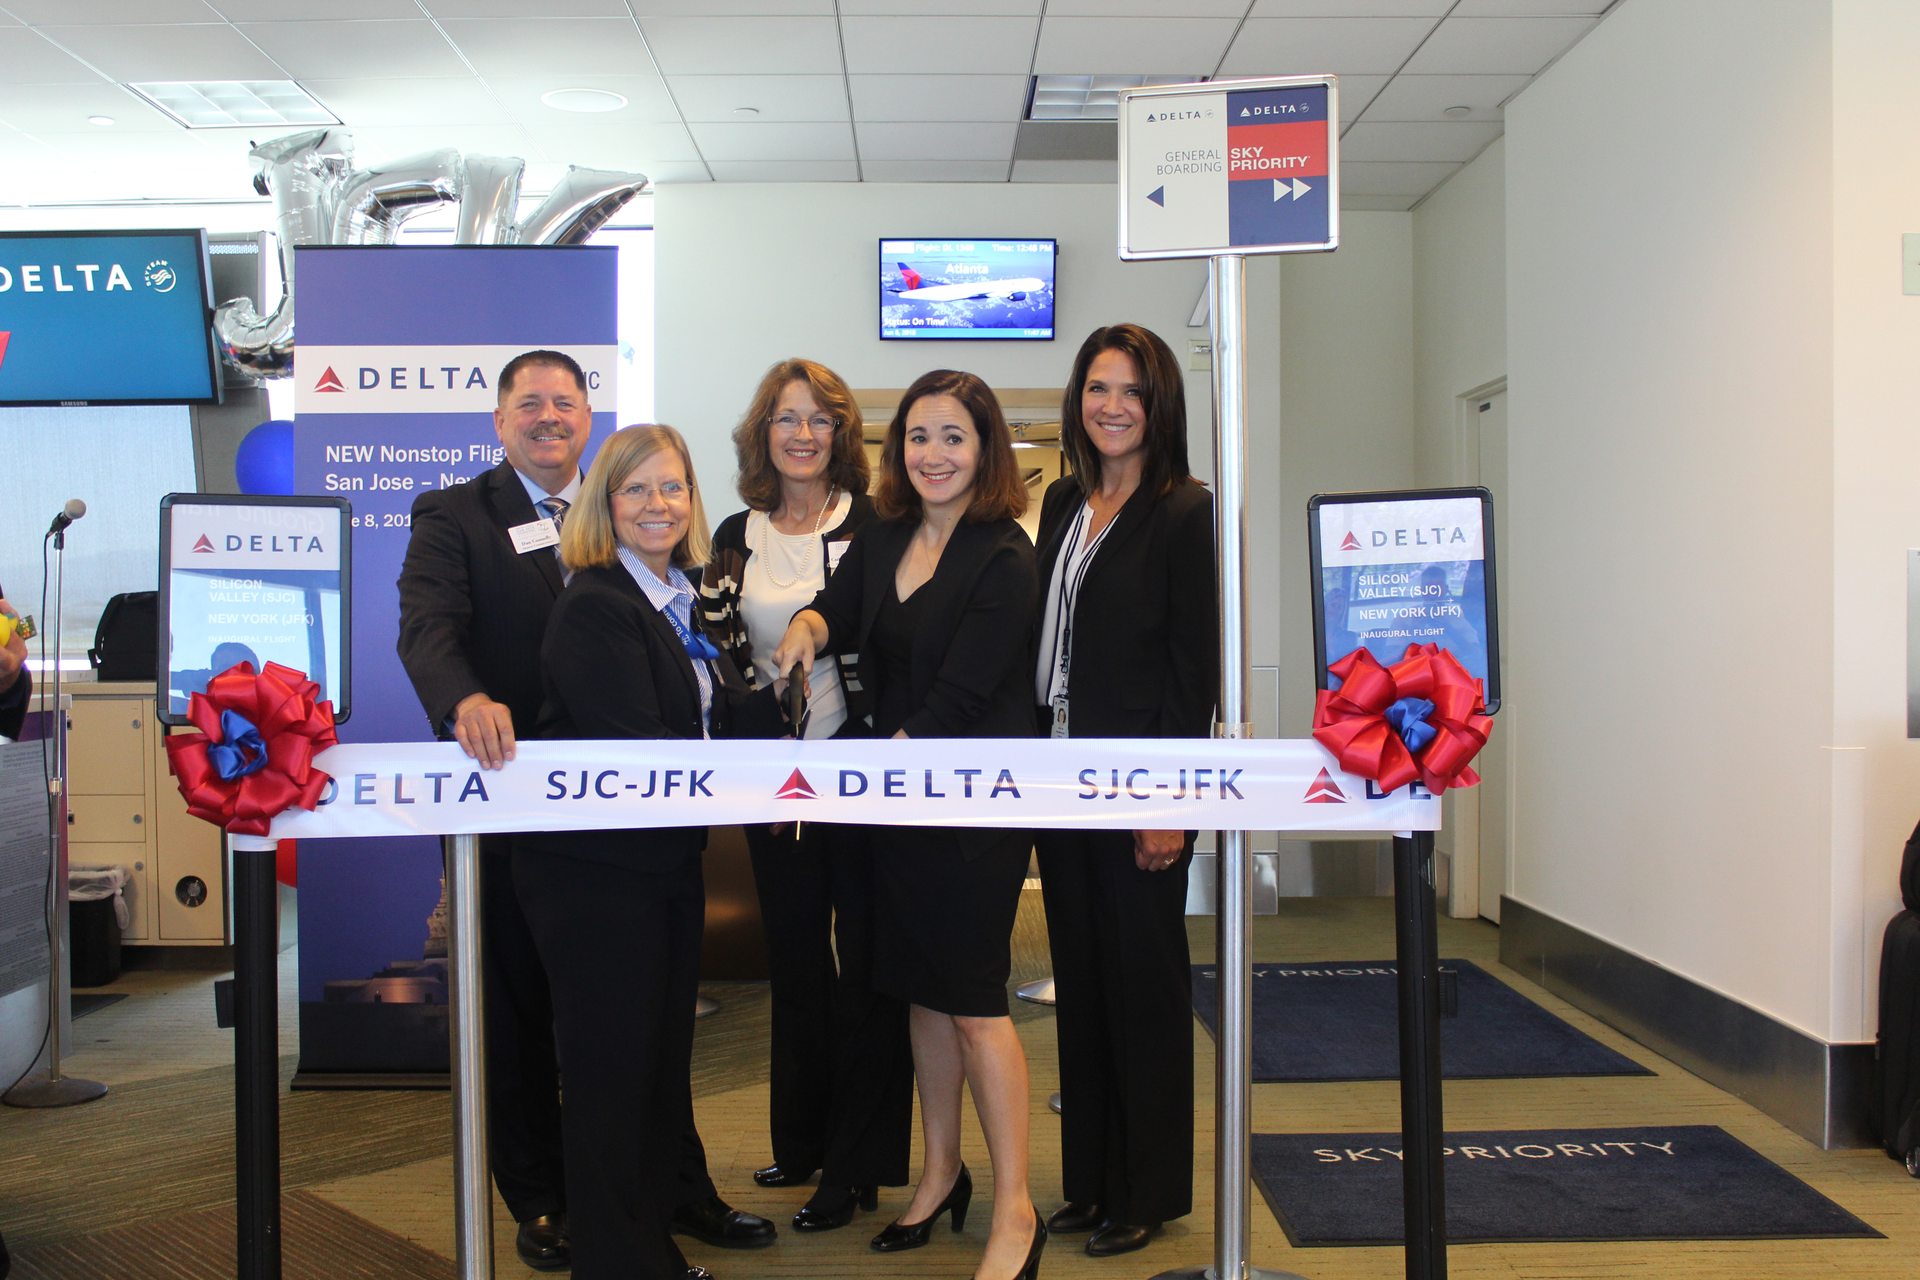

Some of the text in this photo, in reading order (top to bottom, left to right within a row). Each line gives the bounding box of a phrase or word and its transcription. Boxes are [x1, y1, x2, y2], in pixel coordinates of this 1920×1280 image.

[1160, 110, 1201, 122] DELTA
[1254, 104, 1297, 116] DELTA
[1165, 149, 1221, 162] GENERAL
[1230, 146, 1264, 159] SKY
[1156, 161, 1222, 175] BOARDING
[1230, 156, 1308, 171] PRIORITY
[915, 244, 941, 253] Flight:
[942, 244, 954, 252] DL
[992, 244, 1014, 253] Time:
[1039, 244, 1052, 253] PM
[945, 263, 989, 275] Atlanta
[883, 317, 945, 326] Status: On Time
[1040, 330, 1051, 338] AM
[359, 367, 488, 390] DELTA
[325, 445, 374, 463] NEW
[380, 445, 463, 467] Nonstop
[325, 473, 357, 491] San
[369, 473, 414, 491] Jose
[364, 513, 379, 529] 8,
[1371, 526, 1467, 548] DELTA
[226, 535, 324, 553] DELTA
[209, 579, 262, 590] SILICON
[1359, 573, 1409, 586] SILICON
[1359, 585, 1442, 598] VALLEY (SJC)
[209, 592, 296, 605] VALLEY (SJC)
[1359, 605, 1461, 620] NEW YORK (JFK)
[208, 613, 315, 626] NEW YORK (JFK)
[208, 635, 296, 643] INAUGURAL FLIGHT
[1360, 628, 1445, 639] INAUGURAL FLIGHT
[545, 769, 715, 799] SJC-JFK
[838, 769, 1021, 799] DELTA
[1078, 769, 1245, 801] SJC-JFK
